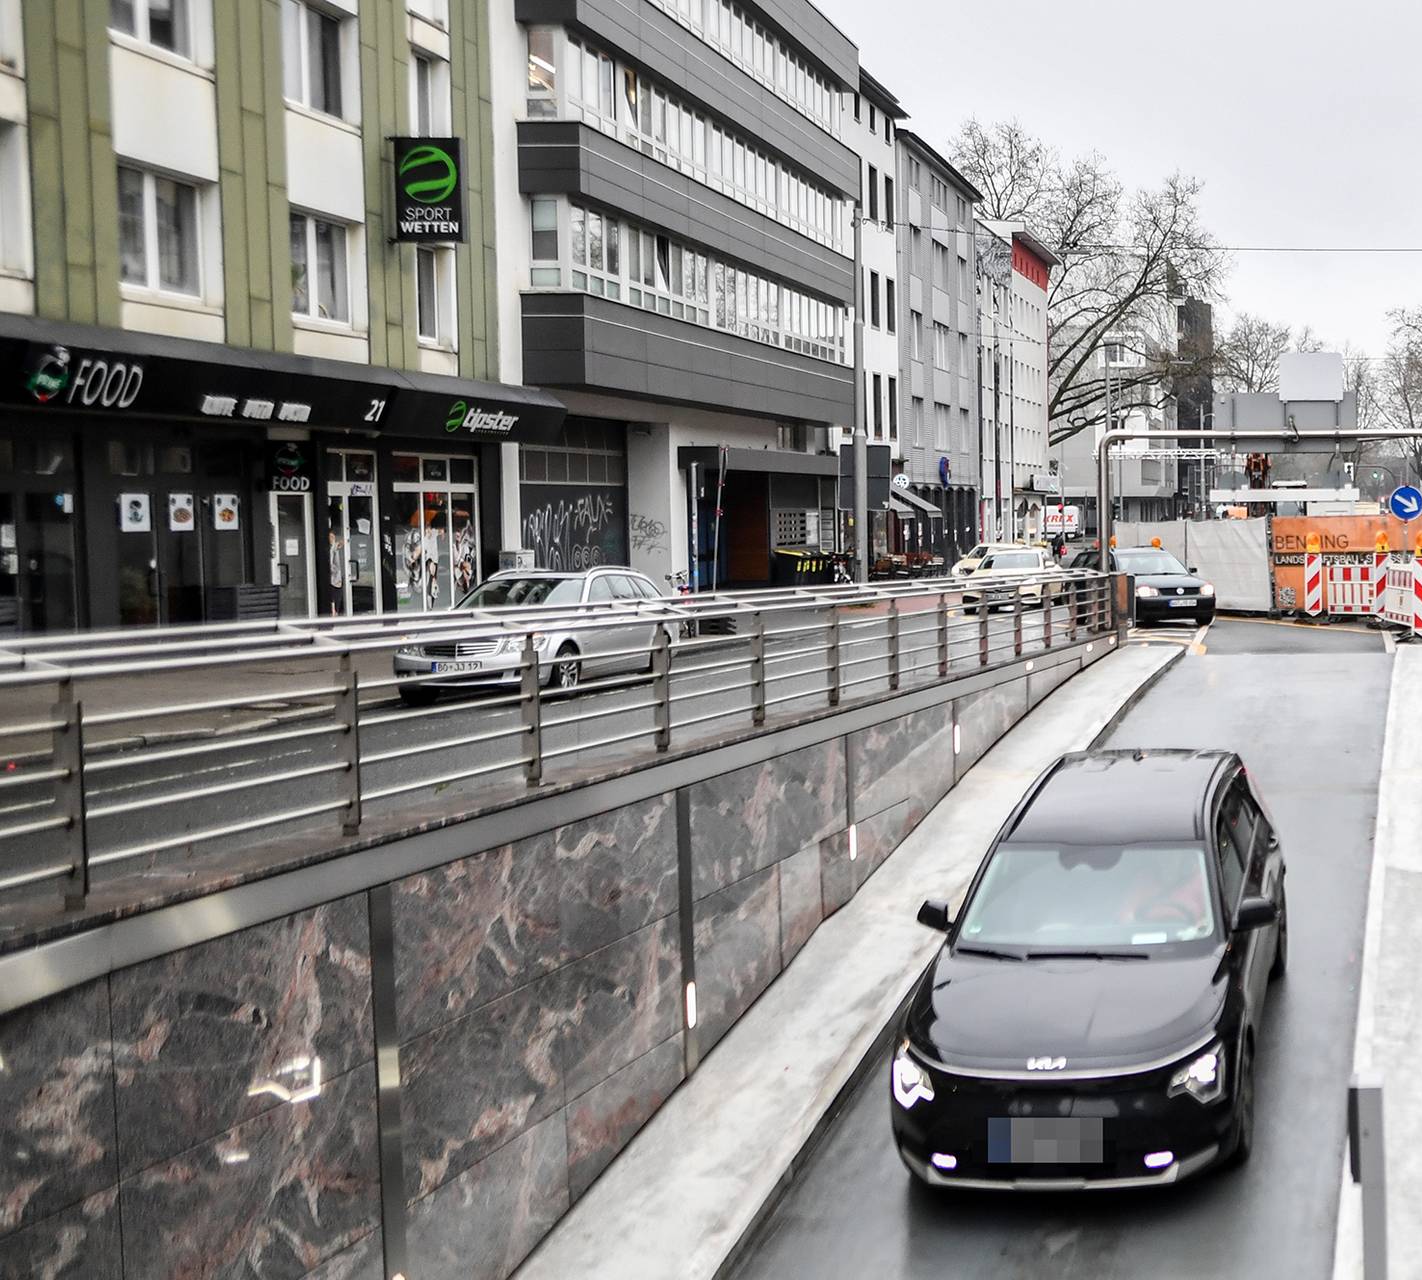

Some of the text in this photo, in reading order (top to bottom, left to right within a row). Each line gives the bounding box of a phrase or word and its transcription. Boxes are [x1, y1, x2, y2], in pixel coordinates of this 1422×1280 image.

[405, 207, 452, 221] SPORT
[400, 221, 459, 233] WETTEN
[67, 359, 143, 408] FOOD
[364, 400, 386, 422] 21
[462, 408, 519, 432] tipster
[272, 475, 310, 490] FOOD
[1275, 534, 1349, 551] BENING
